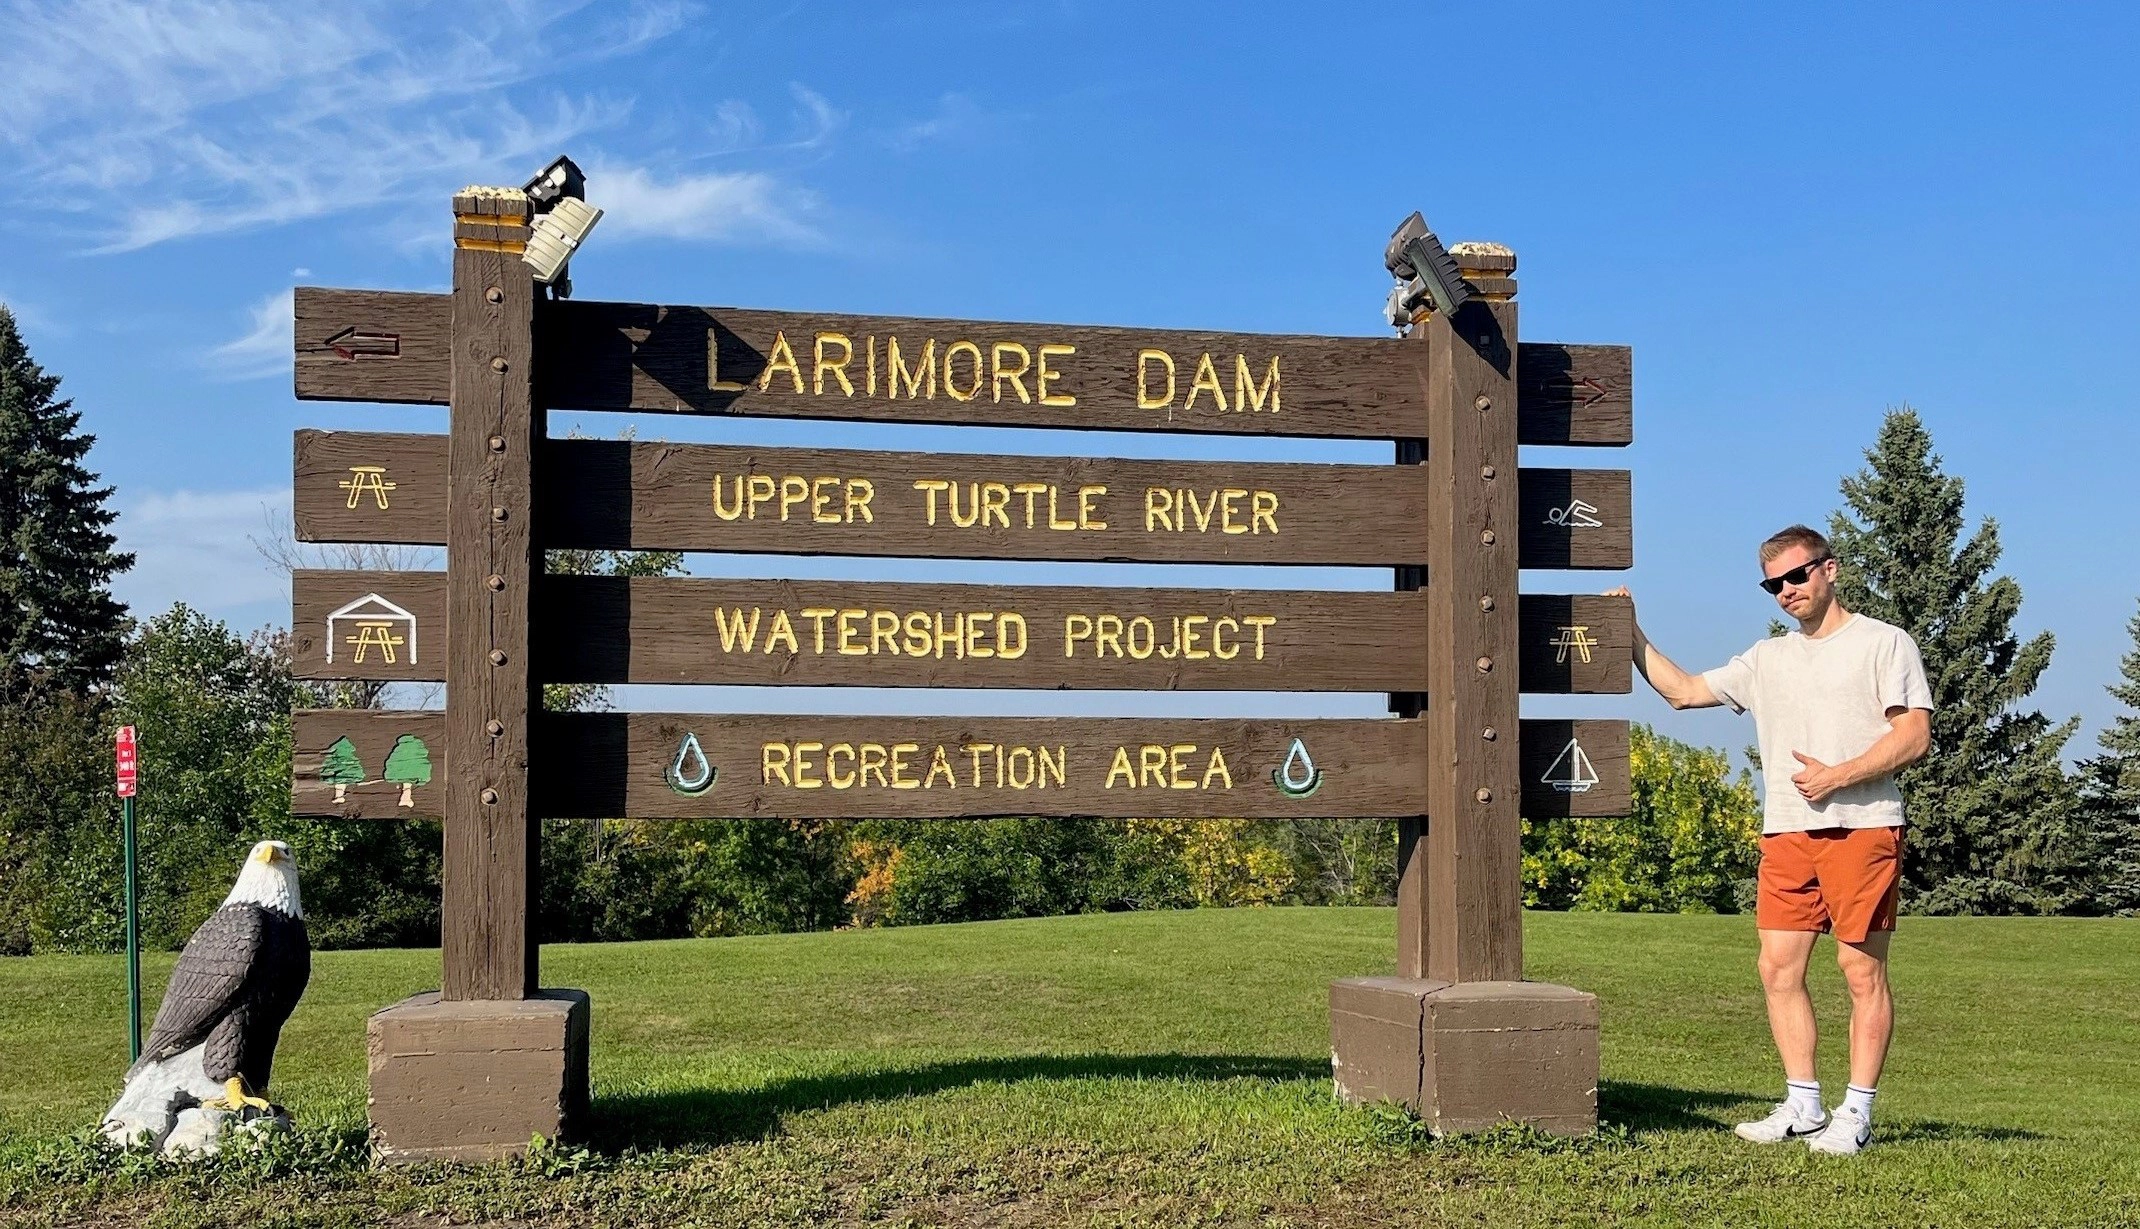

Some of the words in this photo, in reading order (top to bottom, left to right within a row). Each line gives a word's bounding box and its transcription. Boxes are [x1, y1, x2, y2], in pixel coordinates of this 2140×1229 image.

[706, 327, 1076, 406] LARIMORE
[1137, 349, 1280, 413] DAM
[713, 475, 874, 523] UPPER
[913, 480, 1107, 530] TURTLE
[1145, 488, 1278, 534] RIVER
[715, 607, 1027, 660] WATERSHED
[1065, 615, 1276, 660] PROJECT
[761, 743, 1065, 790] RECREATION
[1105, 745, 1233, 789] AREA
